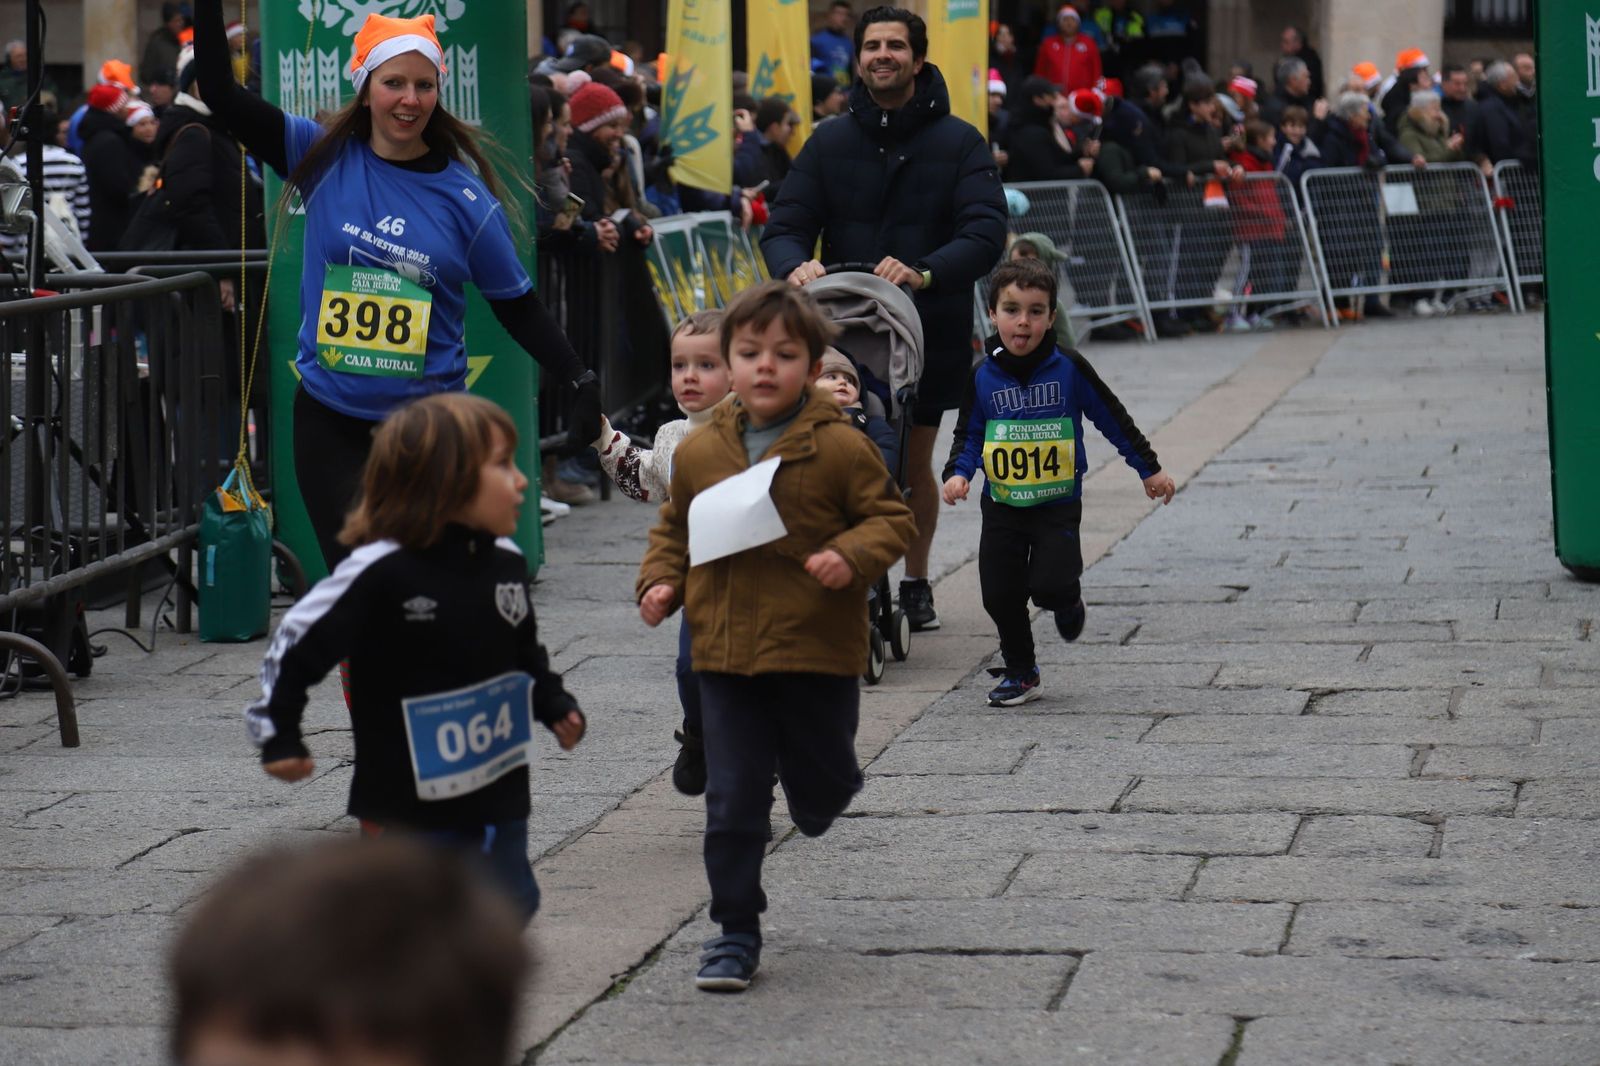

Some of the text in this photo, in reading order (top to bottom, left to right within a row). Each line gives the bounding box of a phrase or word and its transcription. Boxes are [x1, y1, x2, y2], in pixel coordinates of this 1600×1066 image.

[376, 215, 406, 236] 46
[342, 222, 430, 265] SAN SILVESTRE 2025
[352, 279, 401, 292] CAJA RURAL
[325, 298, 412, 345] 398
[344, 354, 417, 371] CAJA RURAL
[992, 381, 1060, 414] PUMA
[1009, 423, 1062, 433] FUNDACION
[1032, 431, 1062, 439] RURAL
[992, 445, 1060, 480] 0914
[1010, 486, 1069, 500] CAJA RURAL
[437, 701, 513, 763] 064
